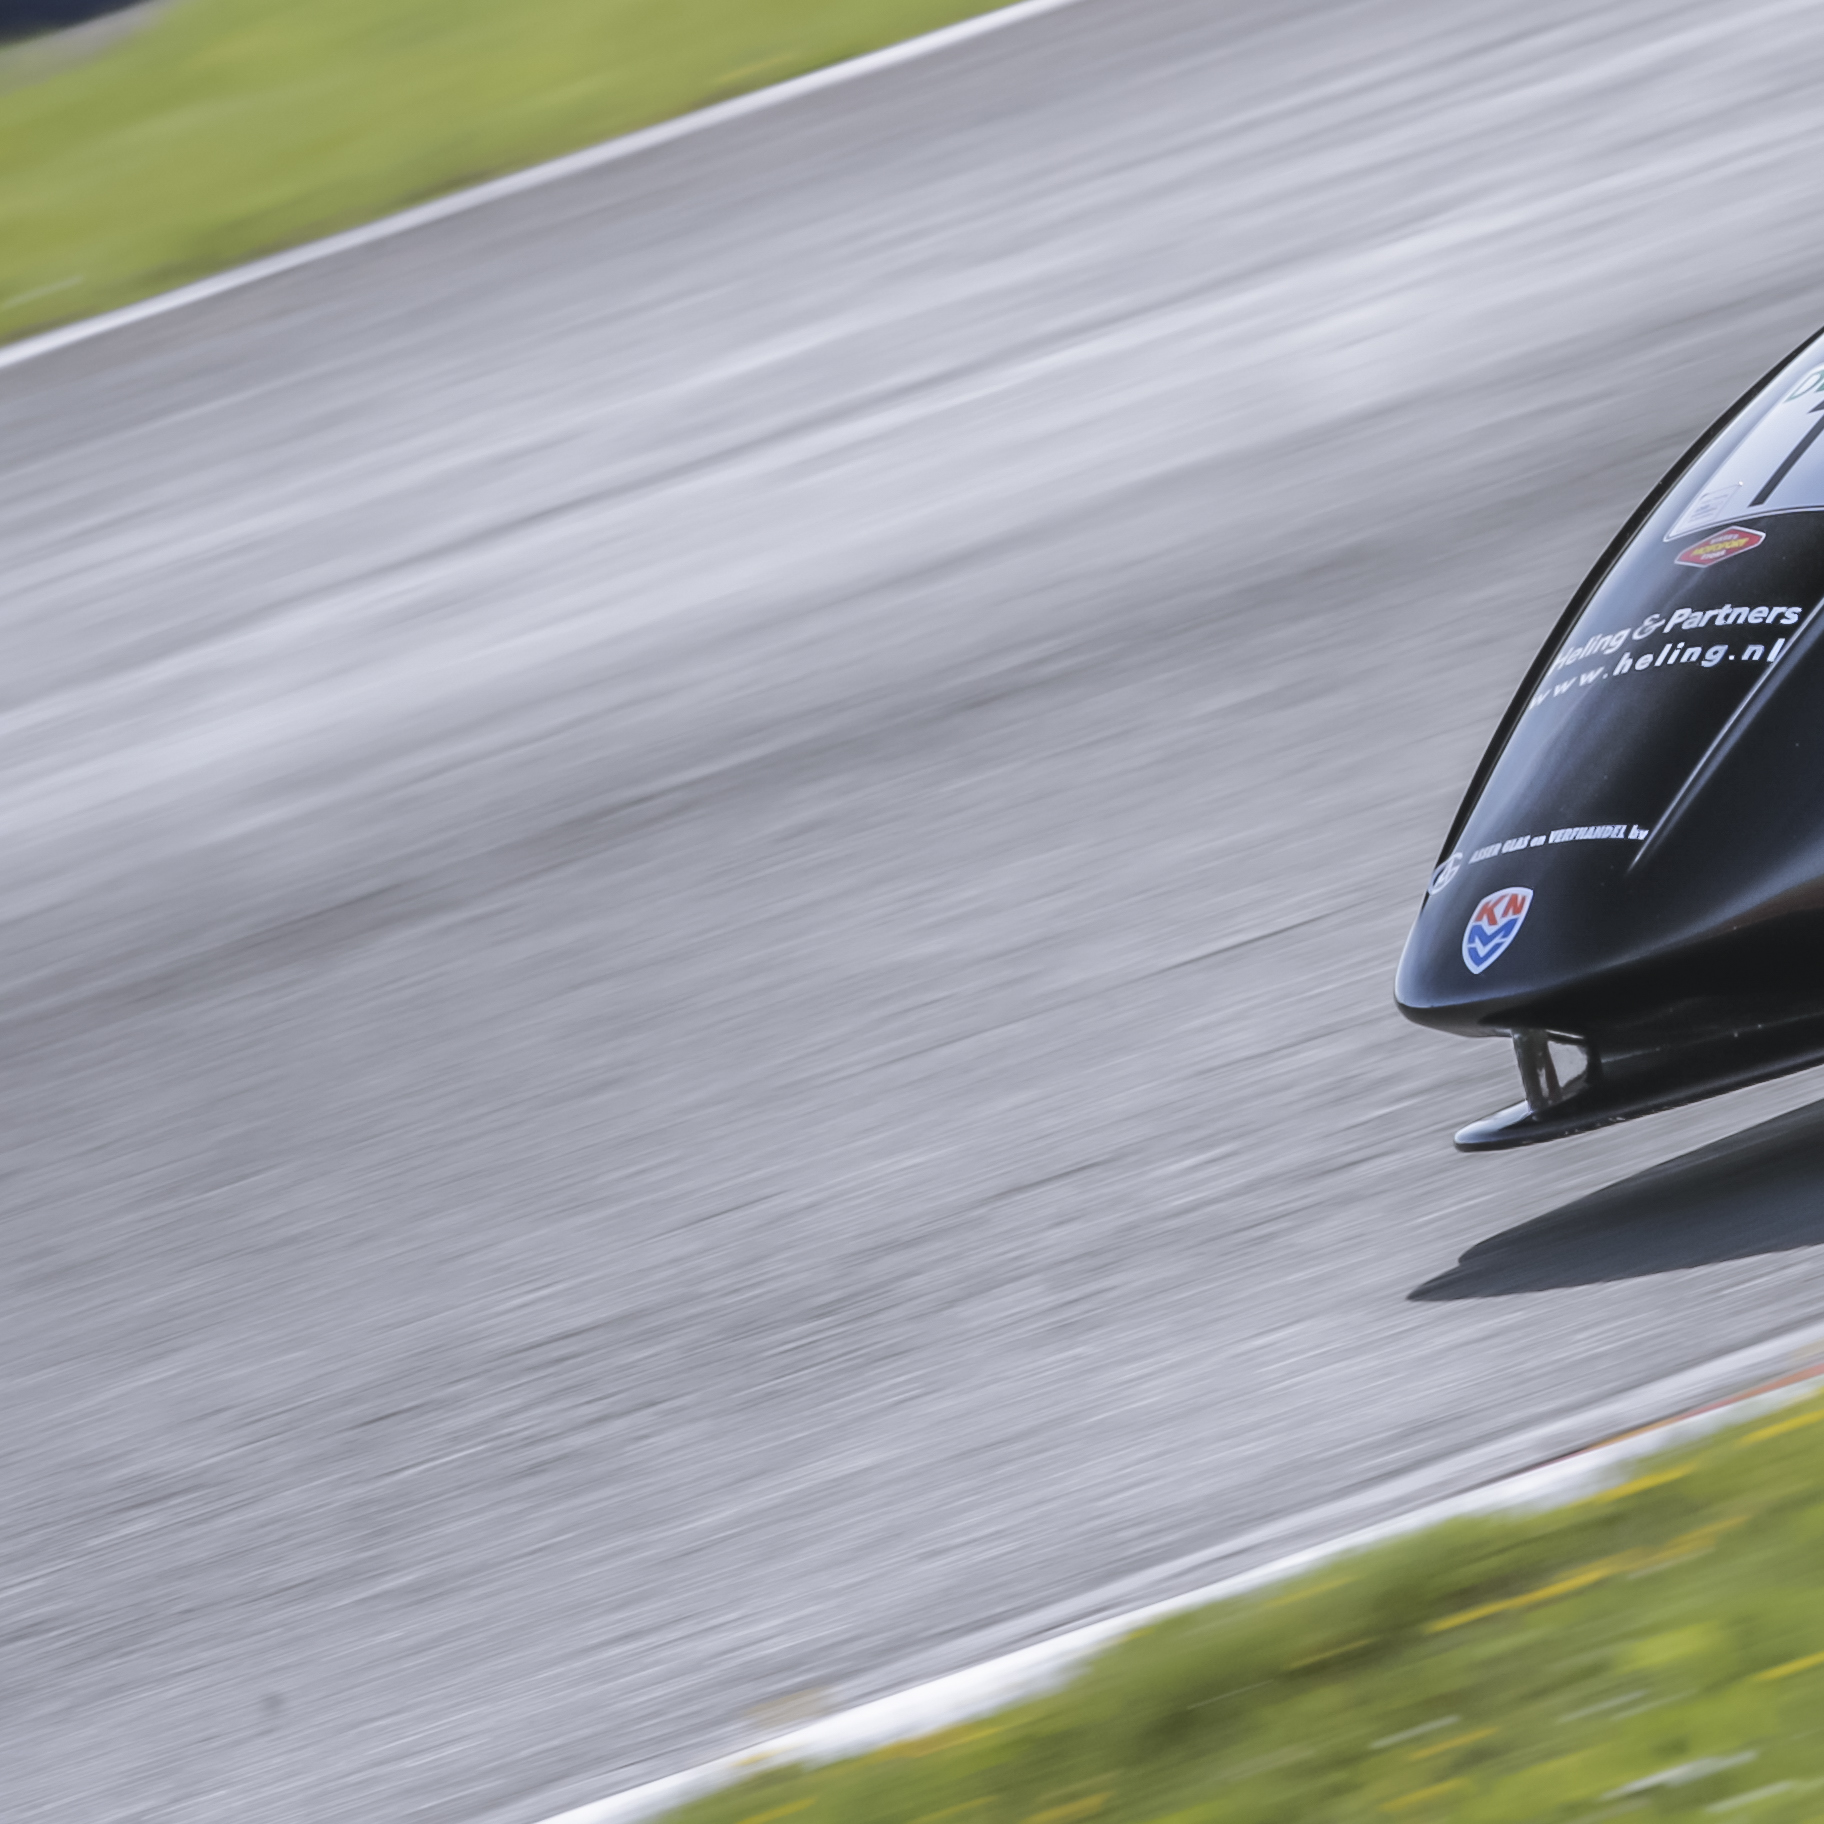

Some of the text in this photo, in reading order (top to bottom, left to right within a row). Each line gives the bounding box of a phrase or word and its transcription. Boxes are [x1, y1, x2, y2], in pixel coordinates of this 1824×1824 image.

[1547, 604, 1802, 676] Heling & Partners
[1501, 834, 1531, 854] GLAS
[1530, 835, 1546, 847] en
[1548, 824, 1628, 844] VERFHANDEL
